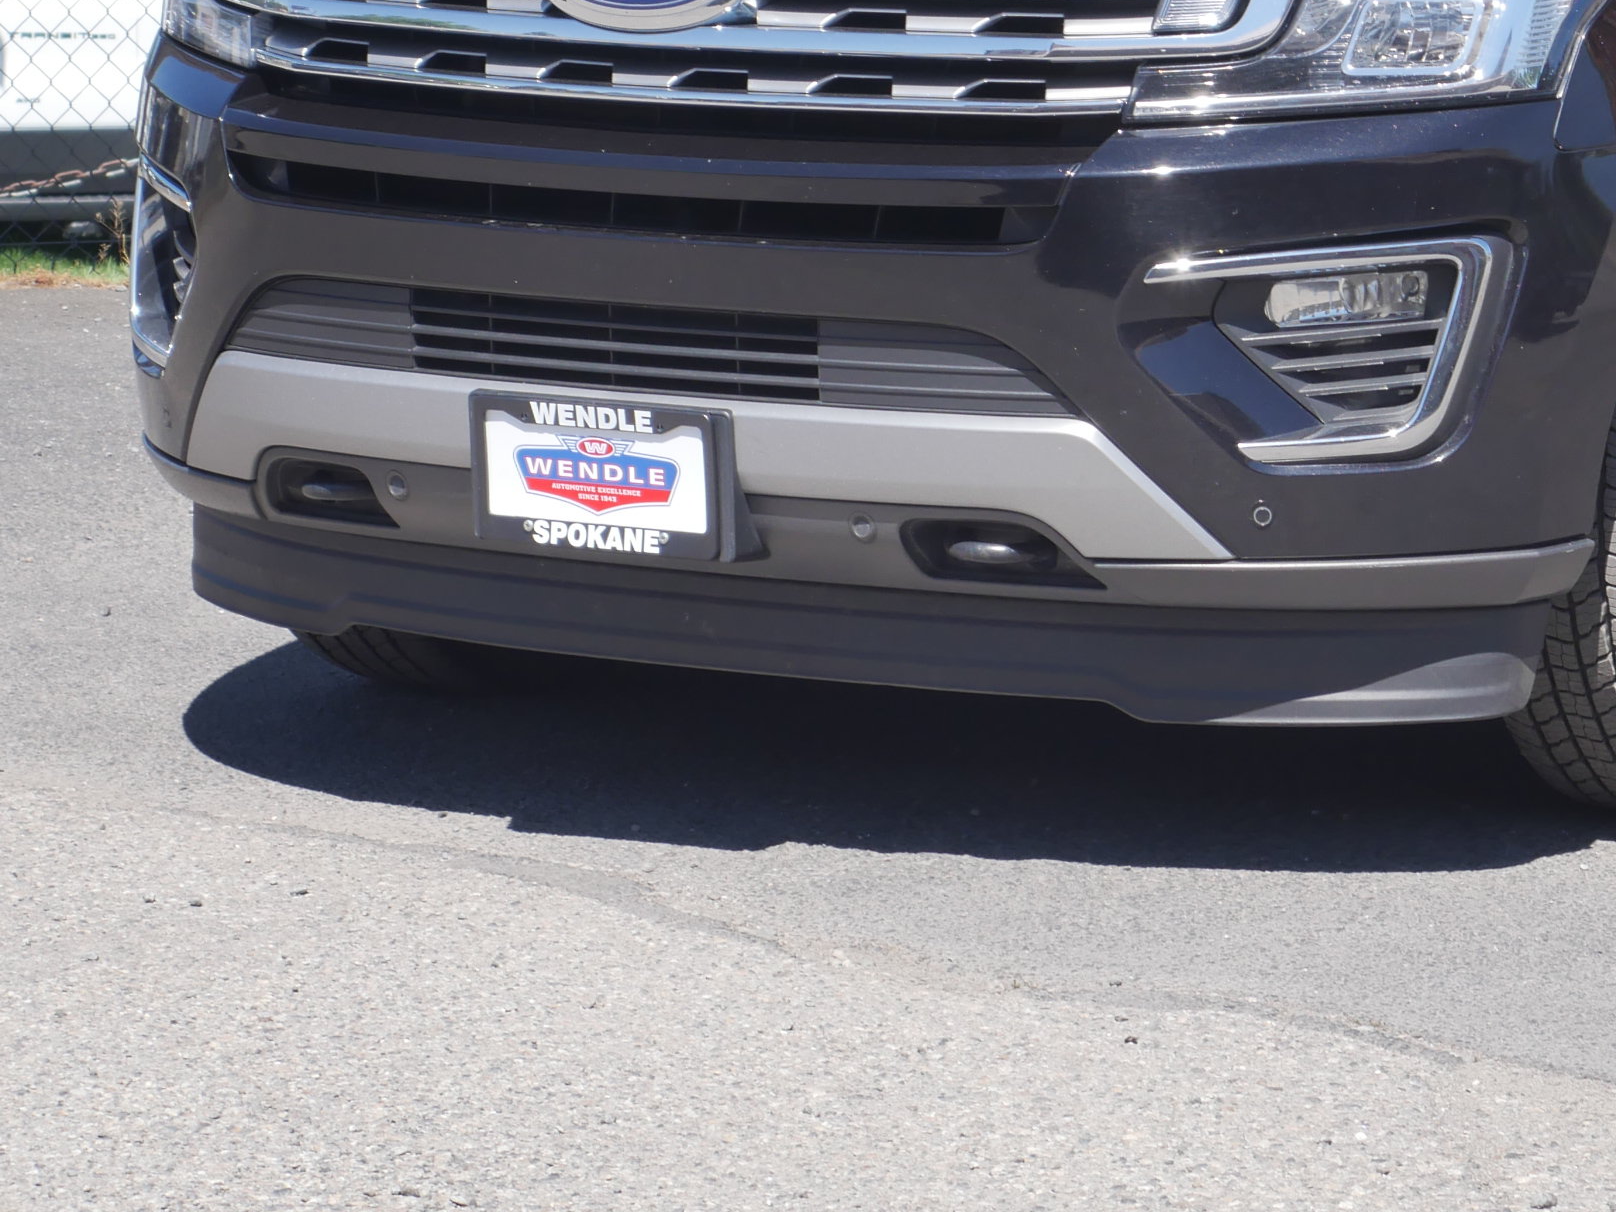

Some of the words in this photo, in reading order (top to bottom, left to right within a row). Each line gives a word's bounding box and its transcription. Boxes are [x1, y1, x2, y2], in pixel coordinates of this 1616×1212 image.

[529, 401, 653, 434] WENDLE
[524, 456, 666, 486] WENDLE
[552, 482, 596, 493] AUTOMOTIVE
[597, 487, 641, 497] EXCELLENCE
[578, 492, 599, 501] SINCE
[532, 519, 661, 554] SPOKANE
